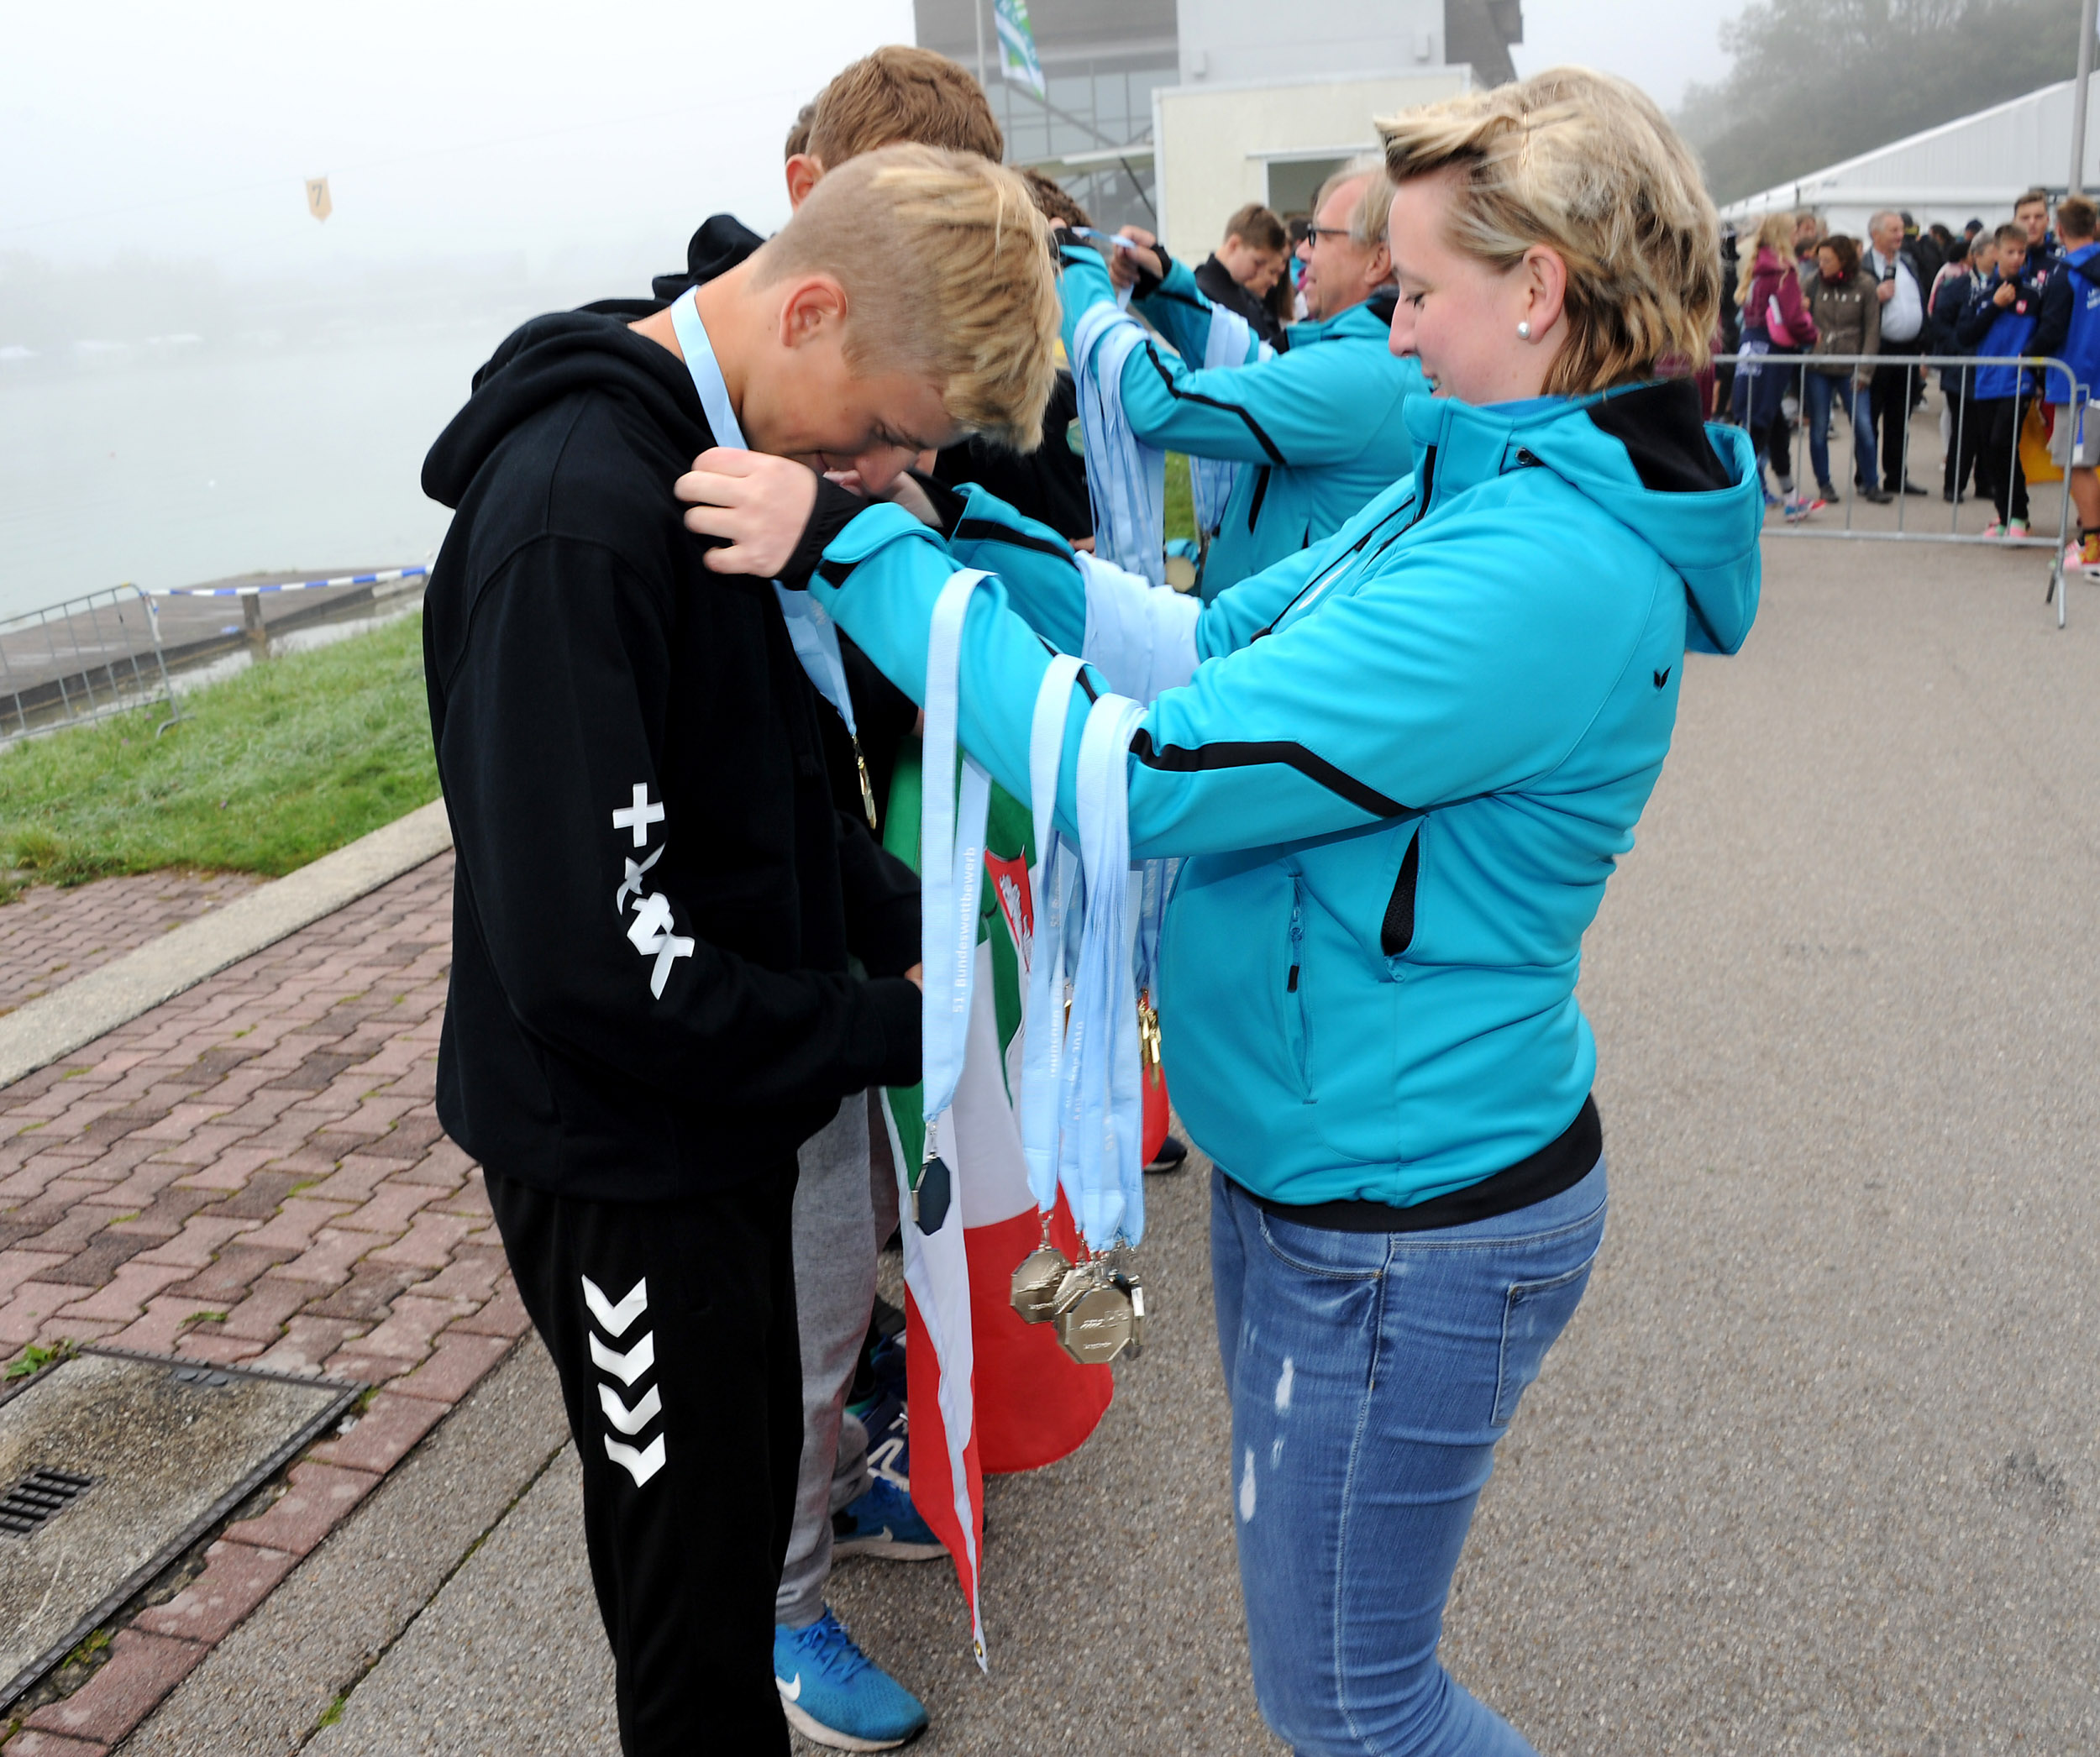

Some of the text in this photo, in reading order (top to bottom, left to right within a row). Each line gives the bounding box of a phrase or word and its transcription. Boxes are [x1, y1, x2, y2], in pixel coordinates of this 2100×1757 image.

[312, 183, 323, 207] 7
[953, 847, 976, 1013] 51. Bundeswettbewerb
